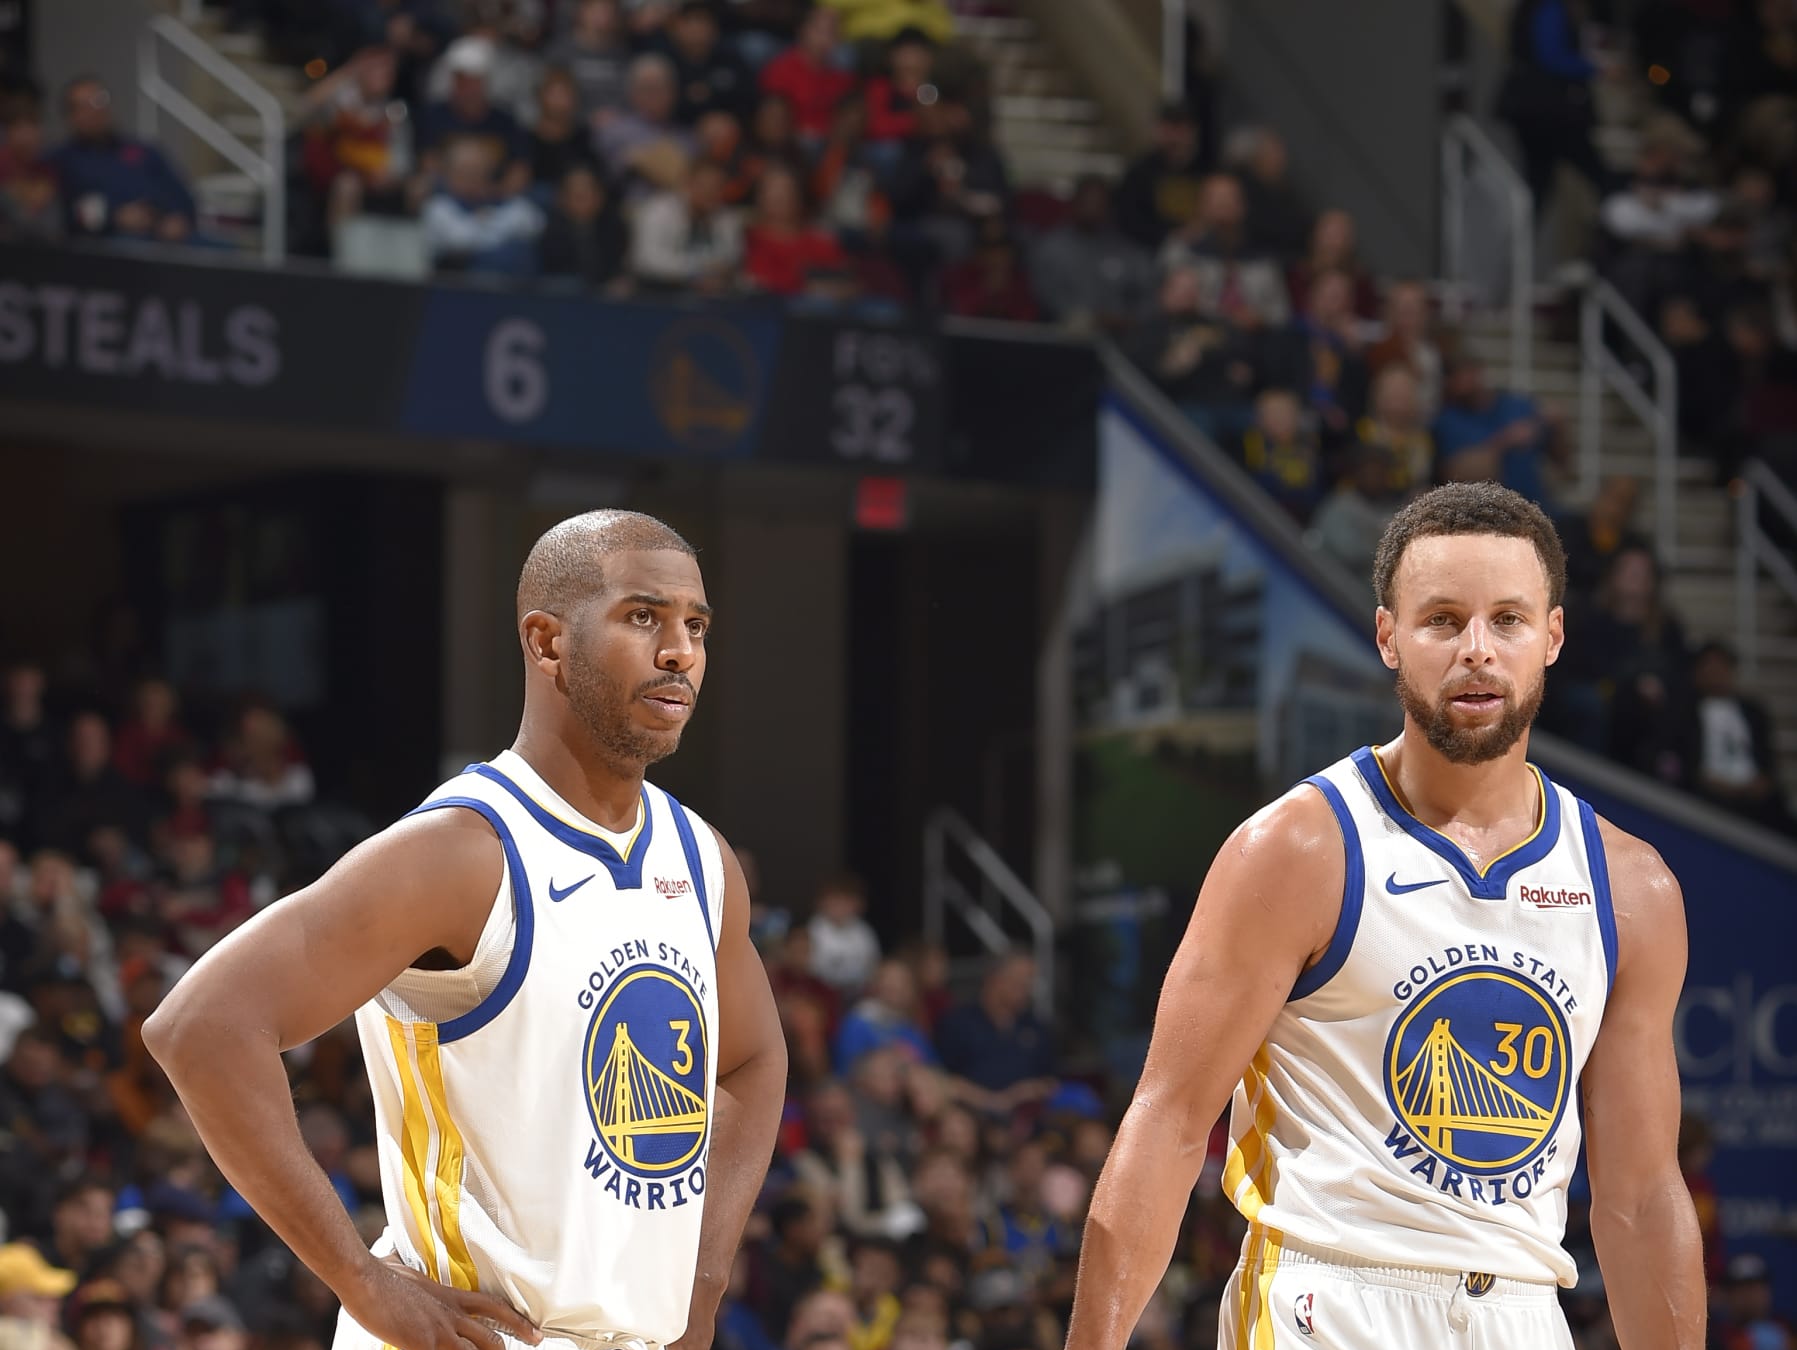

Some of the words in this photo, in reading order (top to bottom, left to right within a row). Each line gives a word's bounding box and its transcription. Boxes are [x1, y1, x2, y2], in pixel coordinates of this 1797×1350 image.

[0, 278, 283, 386] STEALS
[482, 316, 548, 423] 6
[829, 384, 916, 464] 32
[654, 876, 692, 895] Rakuten
[1520, 885, 1592, 906] Rakuten
[577, 938, 650, 1010] GOLDEN
[658, 942, 708, 1001] STATE
[1393, 943, 1499, 1002] GOLDEN
[1512, 950, 1579, 1016] STATE
[669, 1020, 694, 1077] 3
[1489, 1022, 1554, 1080] 30
[583, 1137, 707, 1211] WARRIO
[1384, 1120, 1559, 1206] WARRIORS
